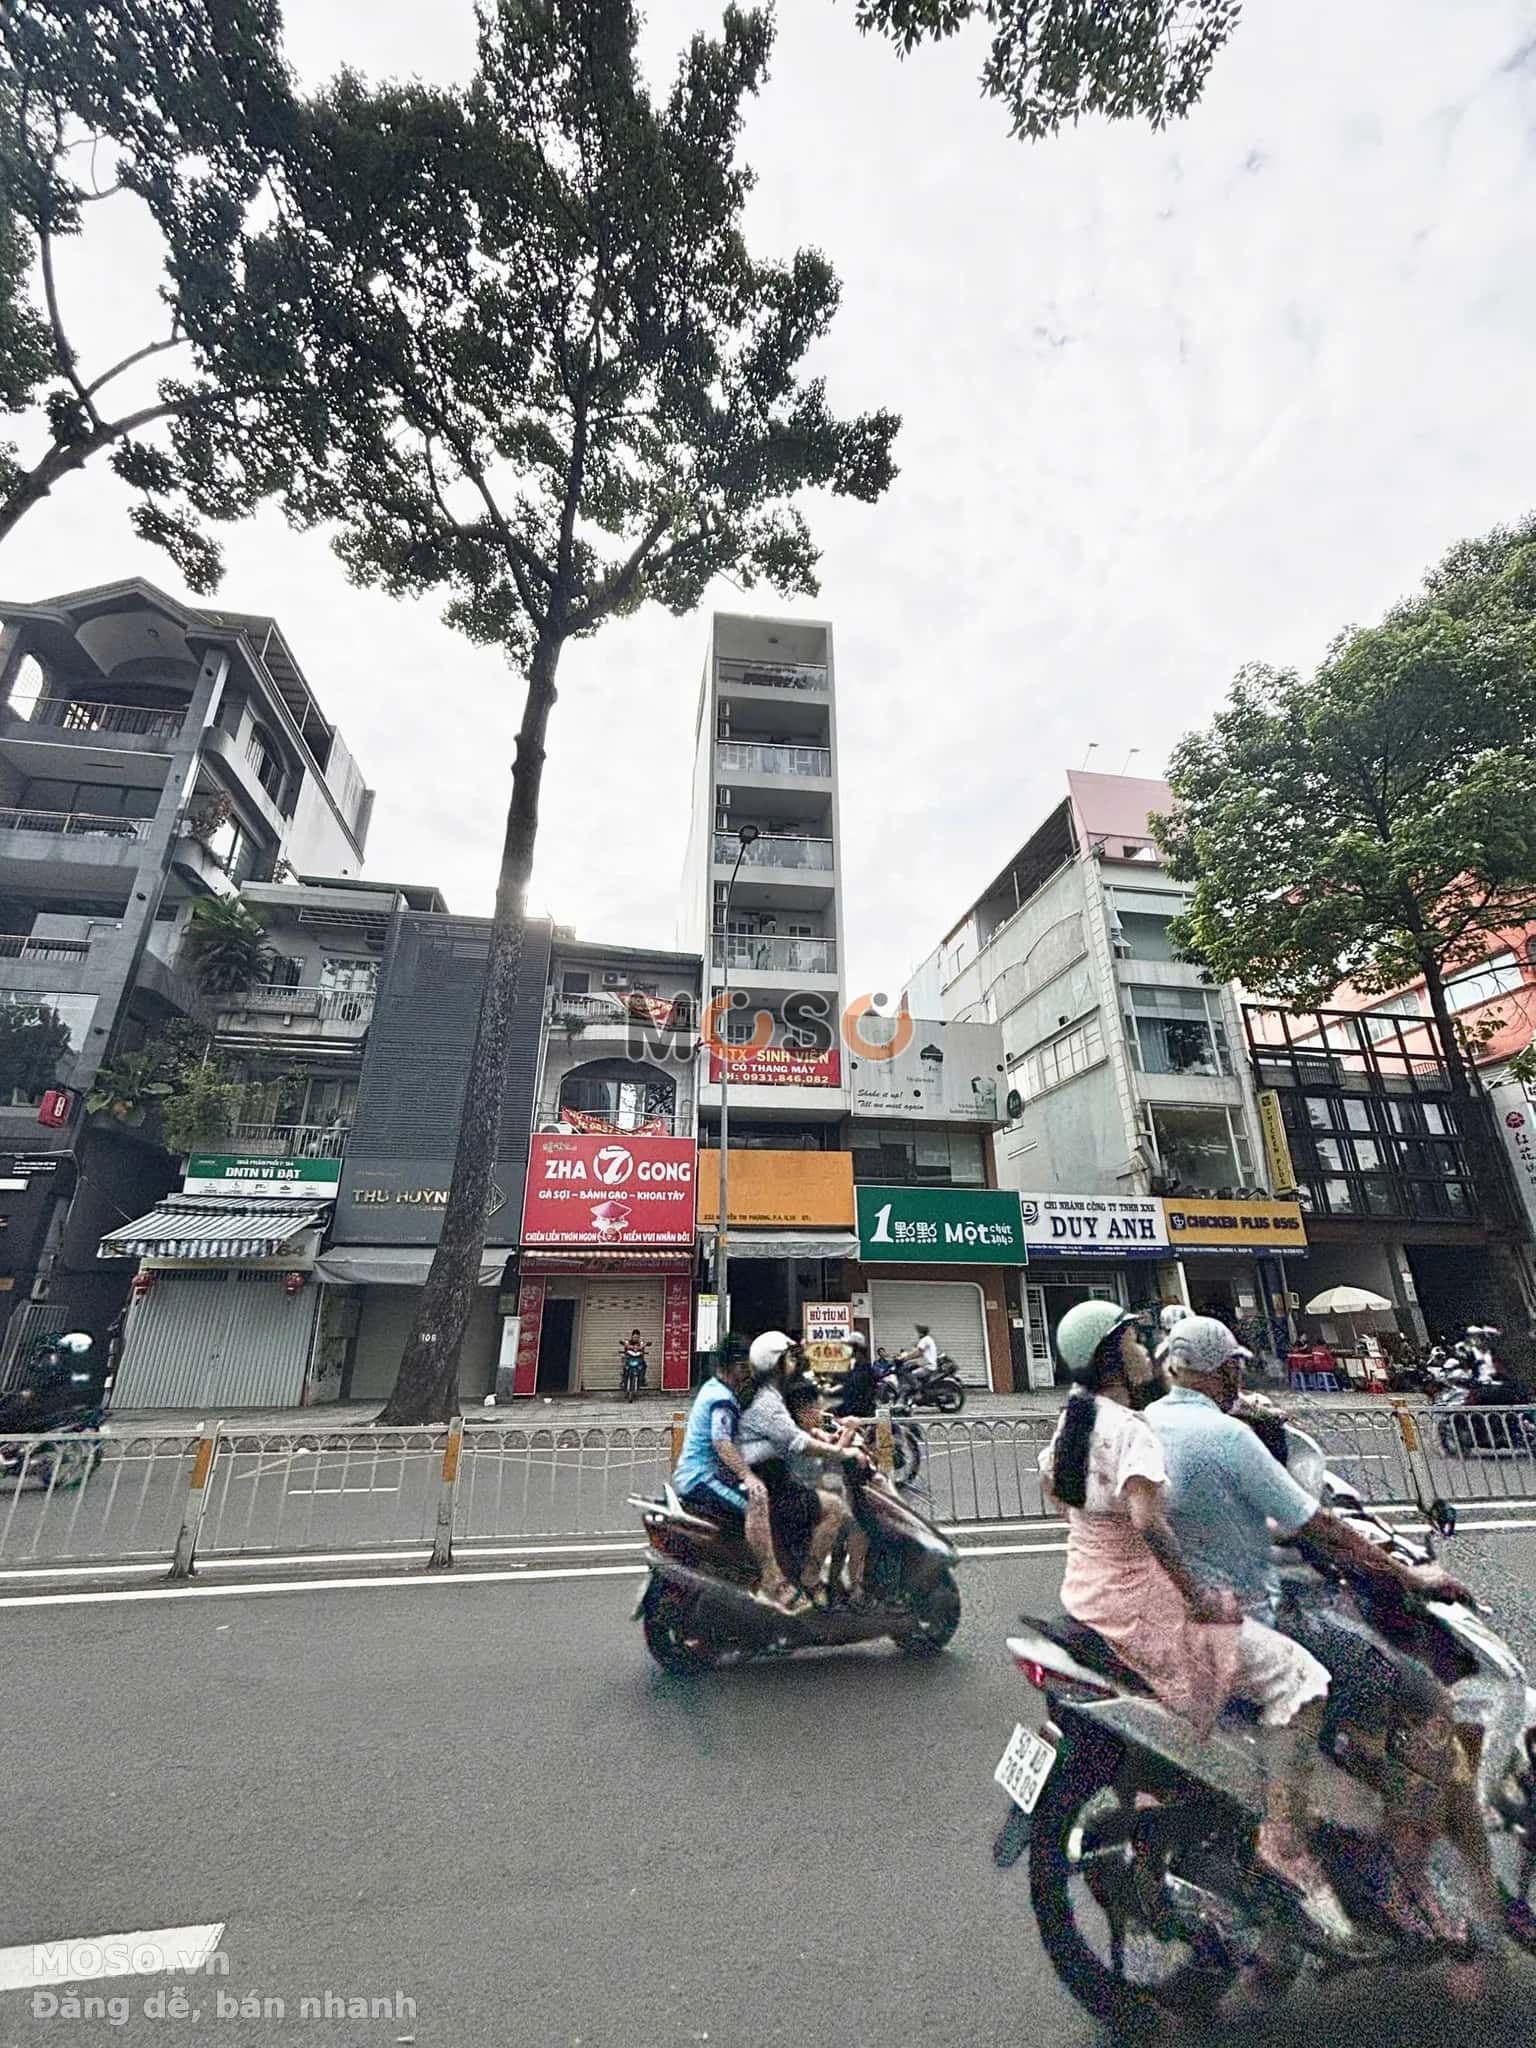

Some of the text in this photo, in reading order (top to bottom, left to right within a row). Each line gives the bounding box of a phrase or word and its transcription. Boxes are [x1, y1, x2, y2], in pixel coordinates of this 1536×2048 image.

[756, 1048, 791, 1062] SINH
[795, 1046, 830, 1064] VIÊN
[731, 1062, 816, 1075] CÓ THANG MÁY
[742, 1072, 830, 1084] 0931.846.082
[225, 1167, 260, 1178] DNTN
[277, 1168, 302, 1181] ĐẠT
[544, 1160, 587, 1180] ZHA
[637, 1162, 691, 1182] GONG
[396, 1187, 450, 1204] HUỲN
[538, 1189, 552, 1200] GÀ
[580, 1188, 606, 1200] BÁNH
[608, 1191, 628, 1202] GẠO
[637, 1191, 666, 1201] KHOAI
[1044, 1201, 1057, 1210] CHI
[1059, 1201, 1085, 1211] NHÁNH
[1086, 1200, 1106, 1212] CÔNG
[1108, 1203, 1117, 1212] TY
[1050, 1216, 1157, 1240] DUY ANH
[1187, 1215, 1238, 1229] CHICKEN
[1241, 1216, 1271, 1230] PLUS
[944, 1221, 991, 1246] Một
